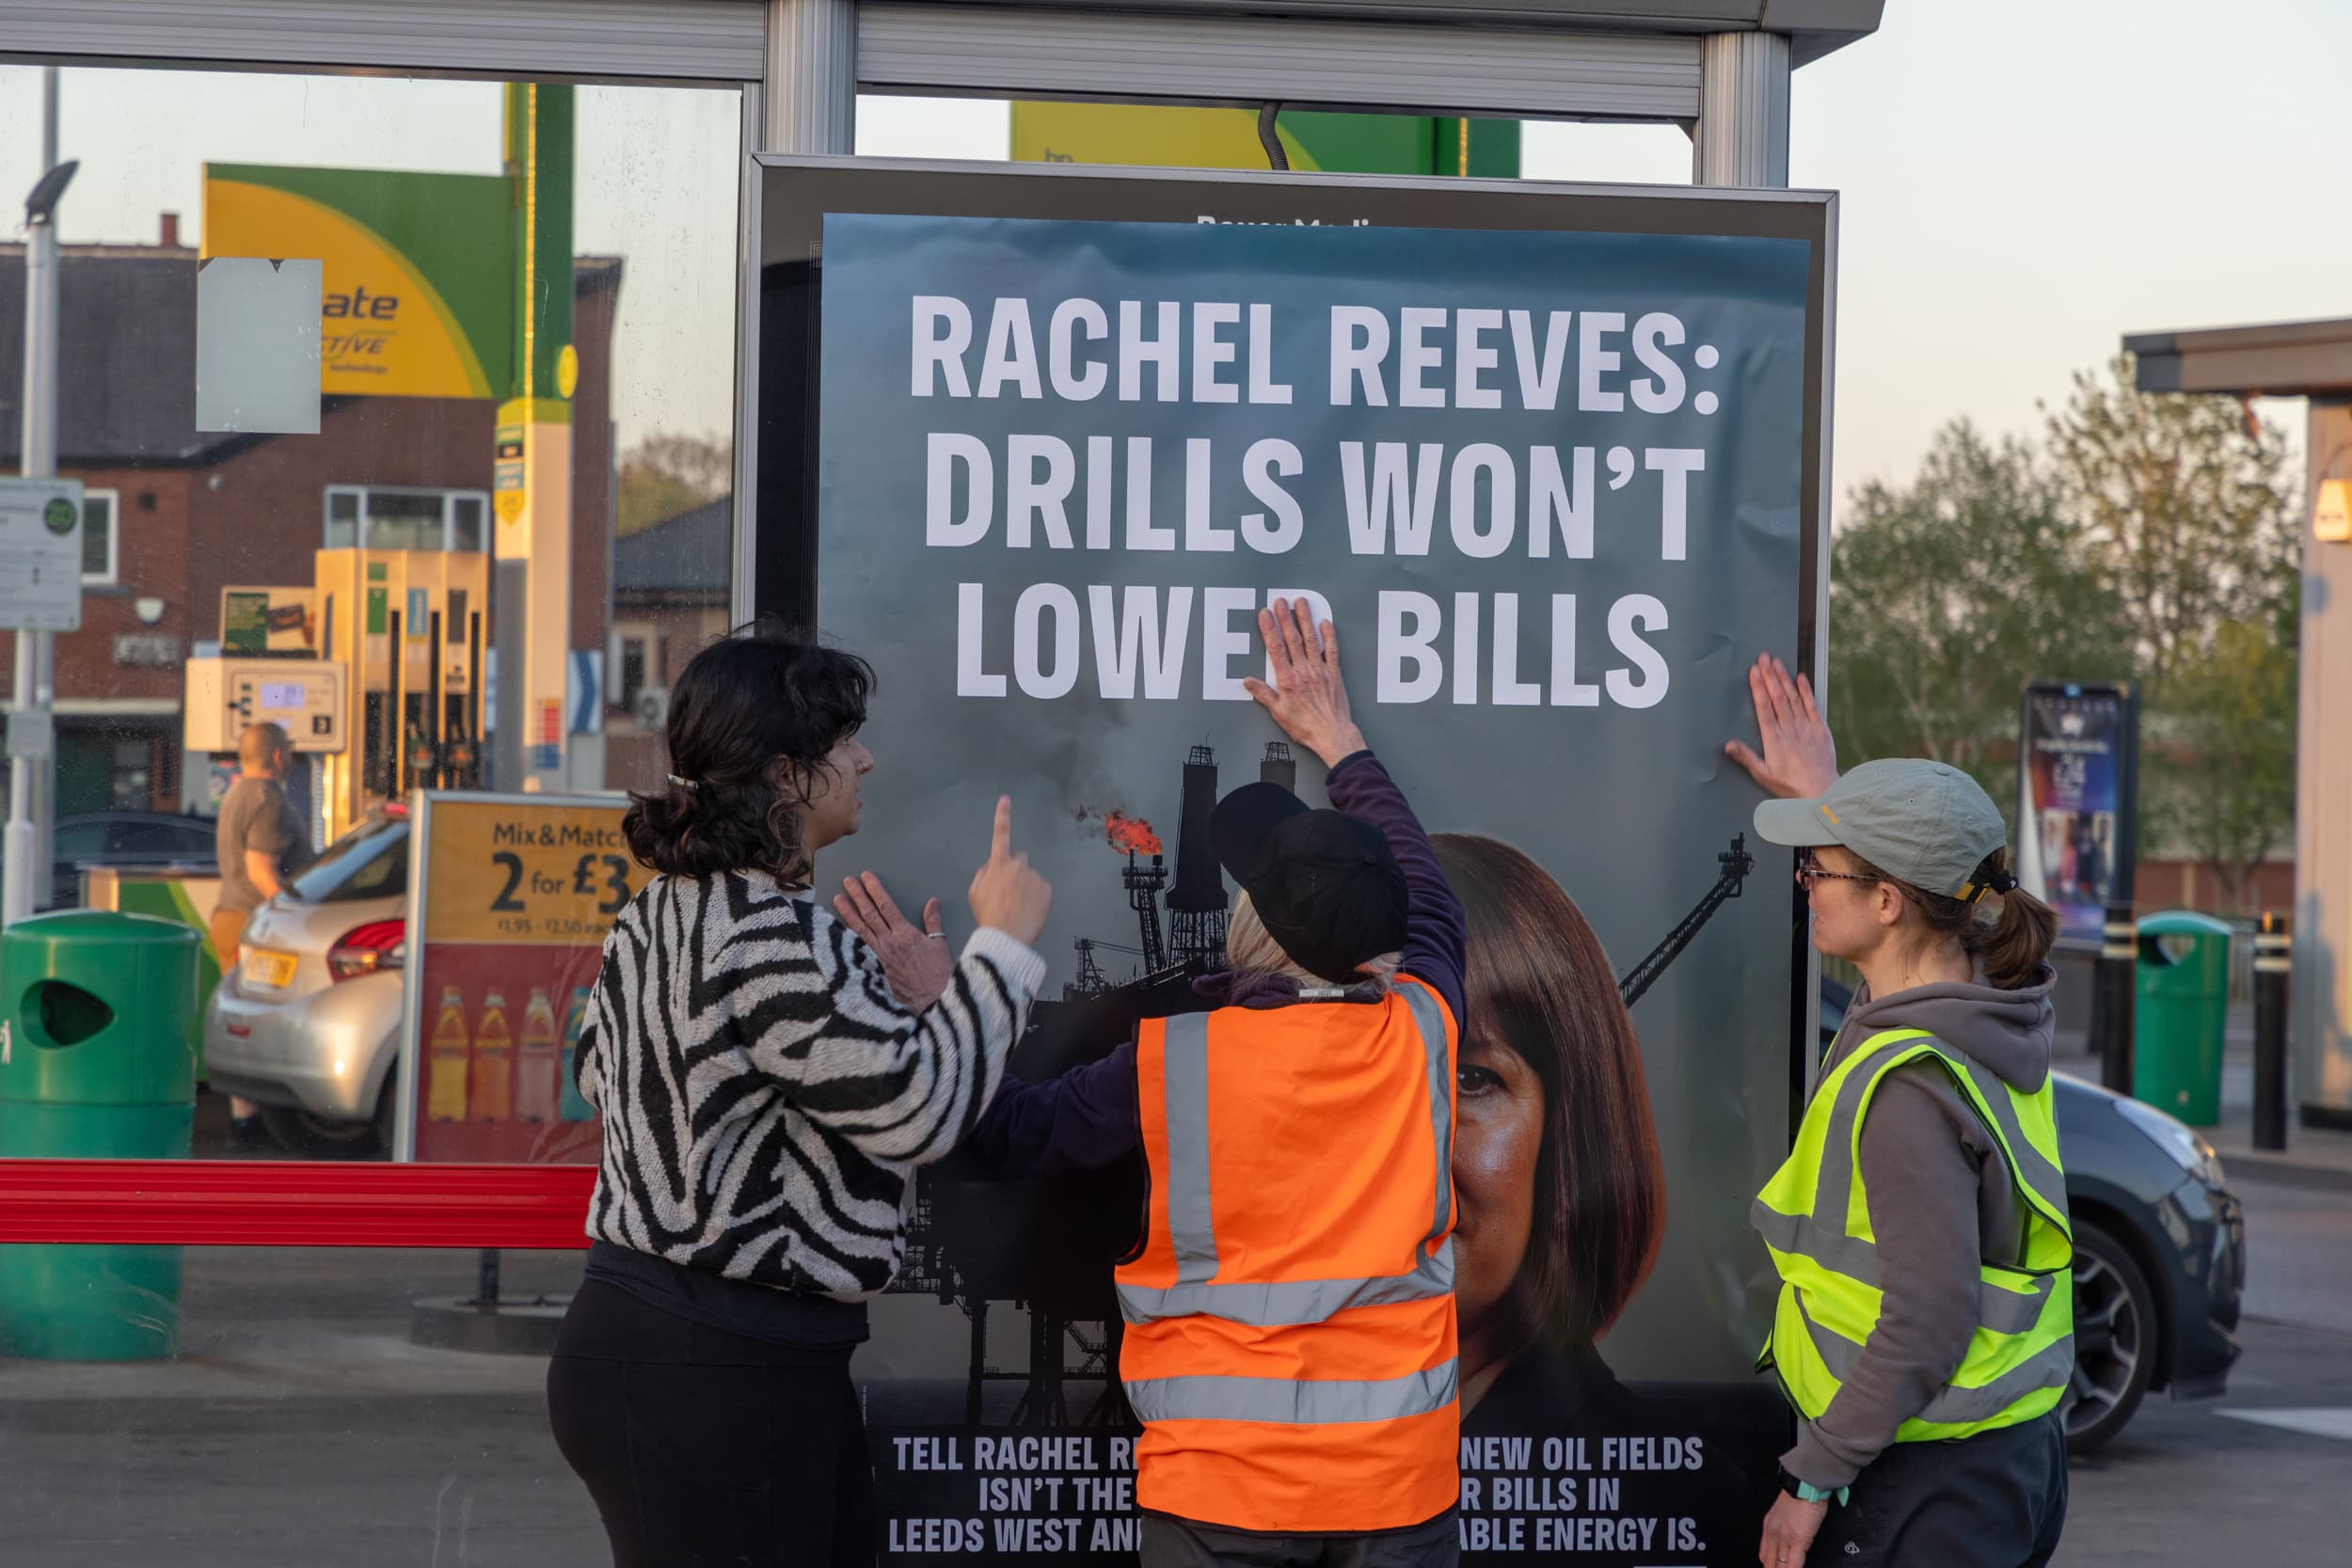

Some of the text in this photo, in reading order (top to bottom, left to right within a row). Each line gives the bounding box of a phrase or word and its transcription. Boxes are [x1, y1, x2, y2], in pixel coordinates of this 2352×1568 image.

[912, 296, 1720, 415] RACHEL REEVES:
[926, 434, 1706, 561] DRILLS WON’T
[1377, 591, 1670, 708] BILLS
[490, 850, 526, 911] 2
[532, 869, 564, 895] for
[893, 1437, 963, 1470] TELL
[975, 1437, 1099, 1470] RACHEL
[1460, 1437, 1533, 1470] NEW
[1544, 1437, 1592, 1470] OIL
[1603, 1437, 1703, 1470] FIELDS
[979, 1478, 1064, 1511] ISN’T
[1073, 1478, 1132, 1511] THE
[1492, 1478, 1577, 1511] BILLS
[1588, 1478, 1619, 1511] IN
[889, 1519, 984, 1552] LEEDS
[993, 1519, 1082, 1552] WEST
[1089, 1519, 1142, 1552] AN
[1536, 1518, 1658, 1551] ENERGY
[1668, 1518, 1706, 1551] IS.
